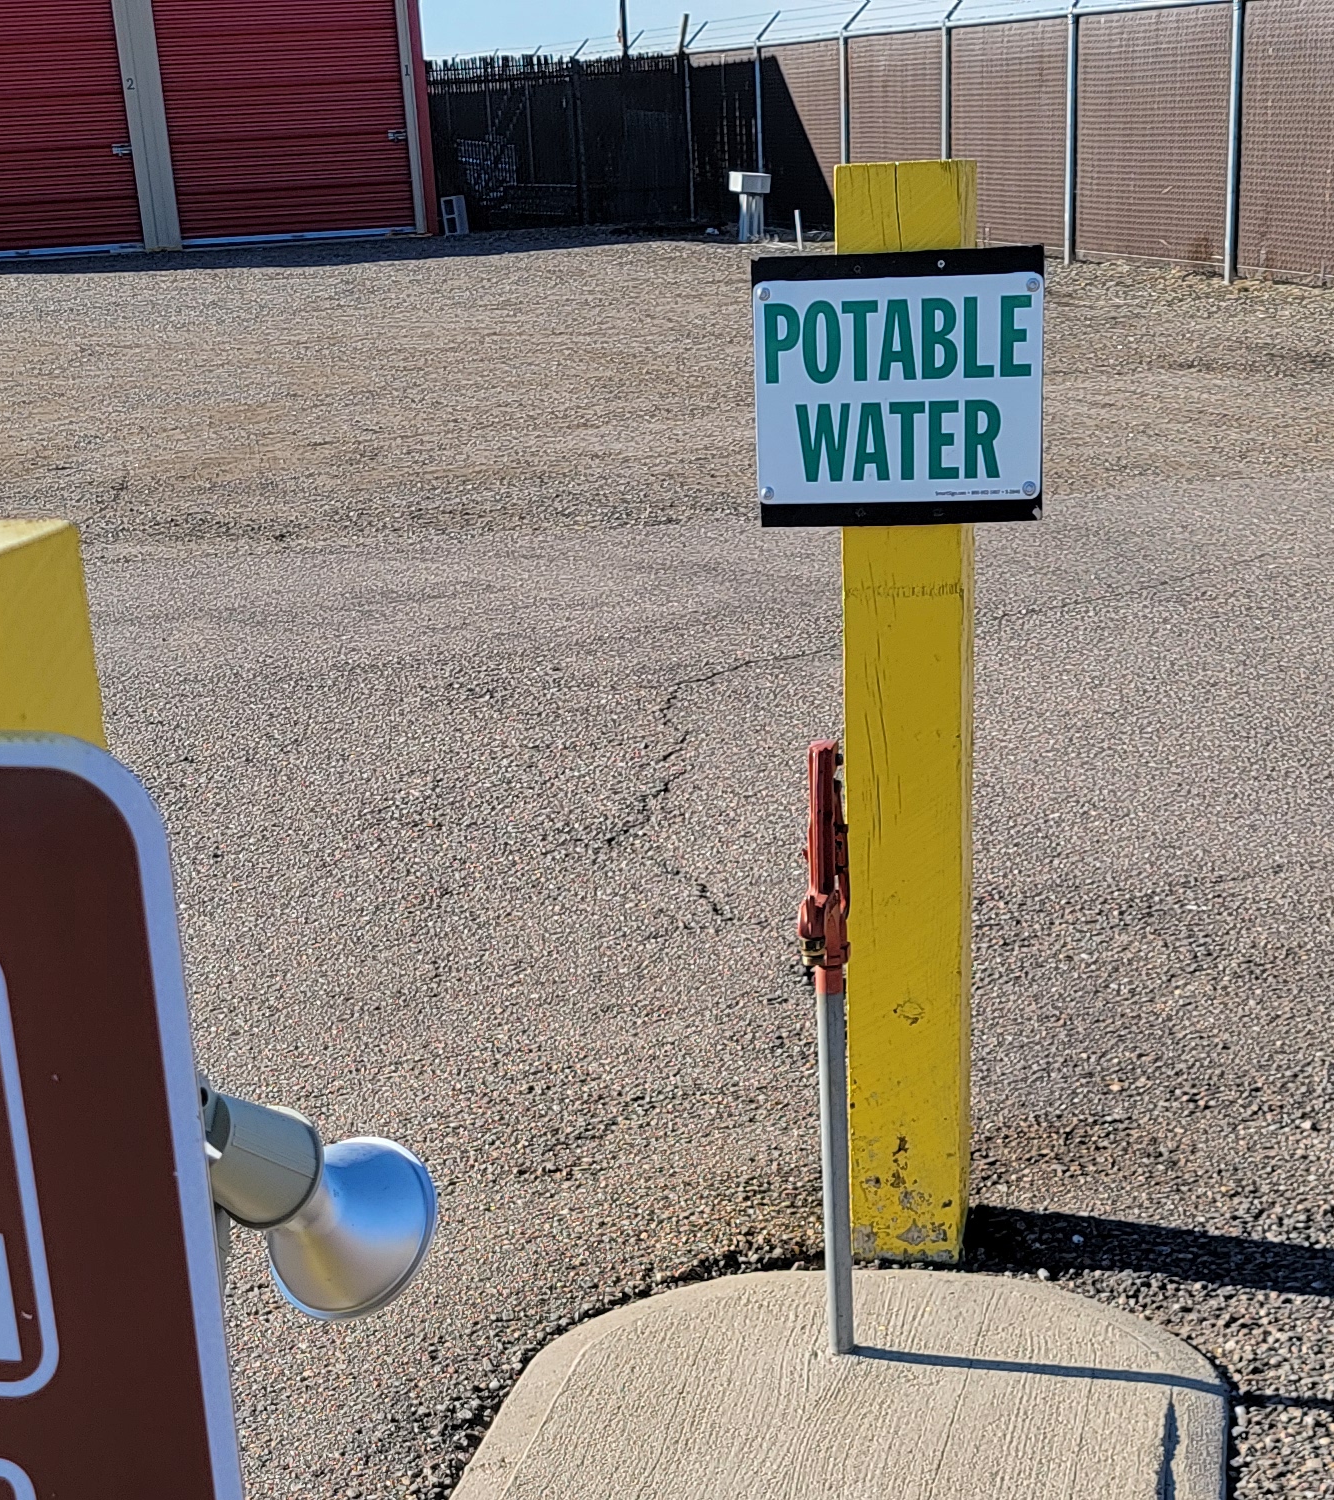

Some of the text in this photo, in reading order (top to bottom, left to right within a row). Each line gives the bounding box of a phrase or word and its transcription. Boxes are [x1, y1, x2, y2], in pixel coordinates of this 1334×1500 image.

[126, 77, 136, 91] 2
[404, 64, 411, 77] 1
[763, 295, 1033, 384] POTABLE
[795, 399, 1002, 483] WATER
